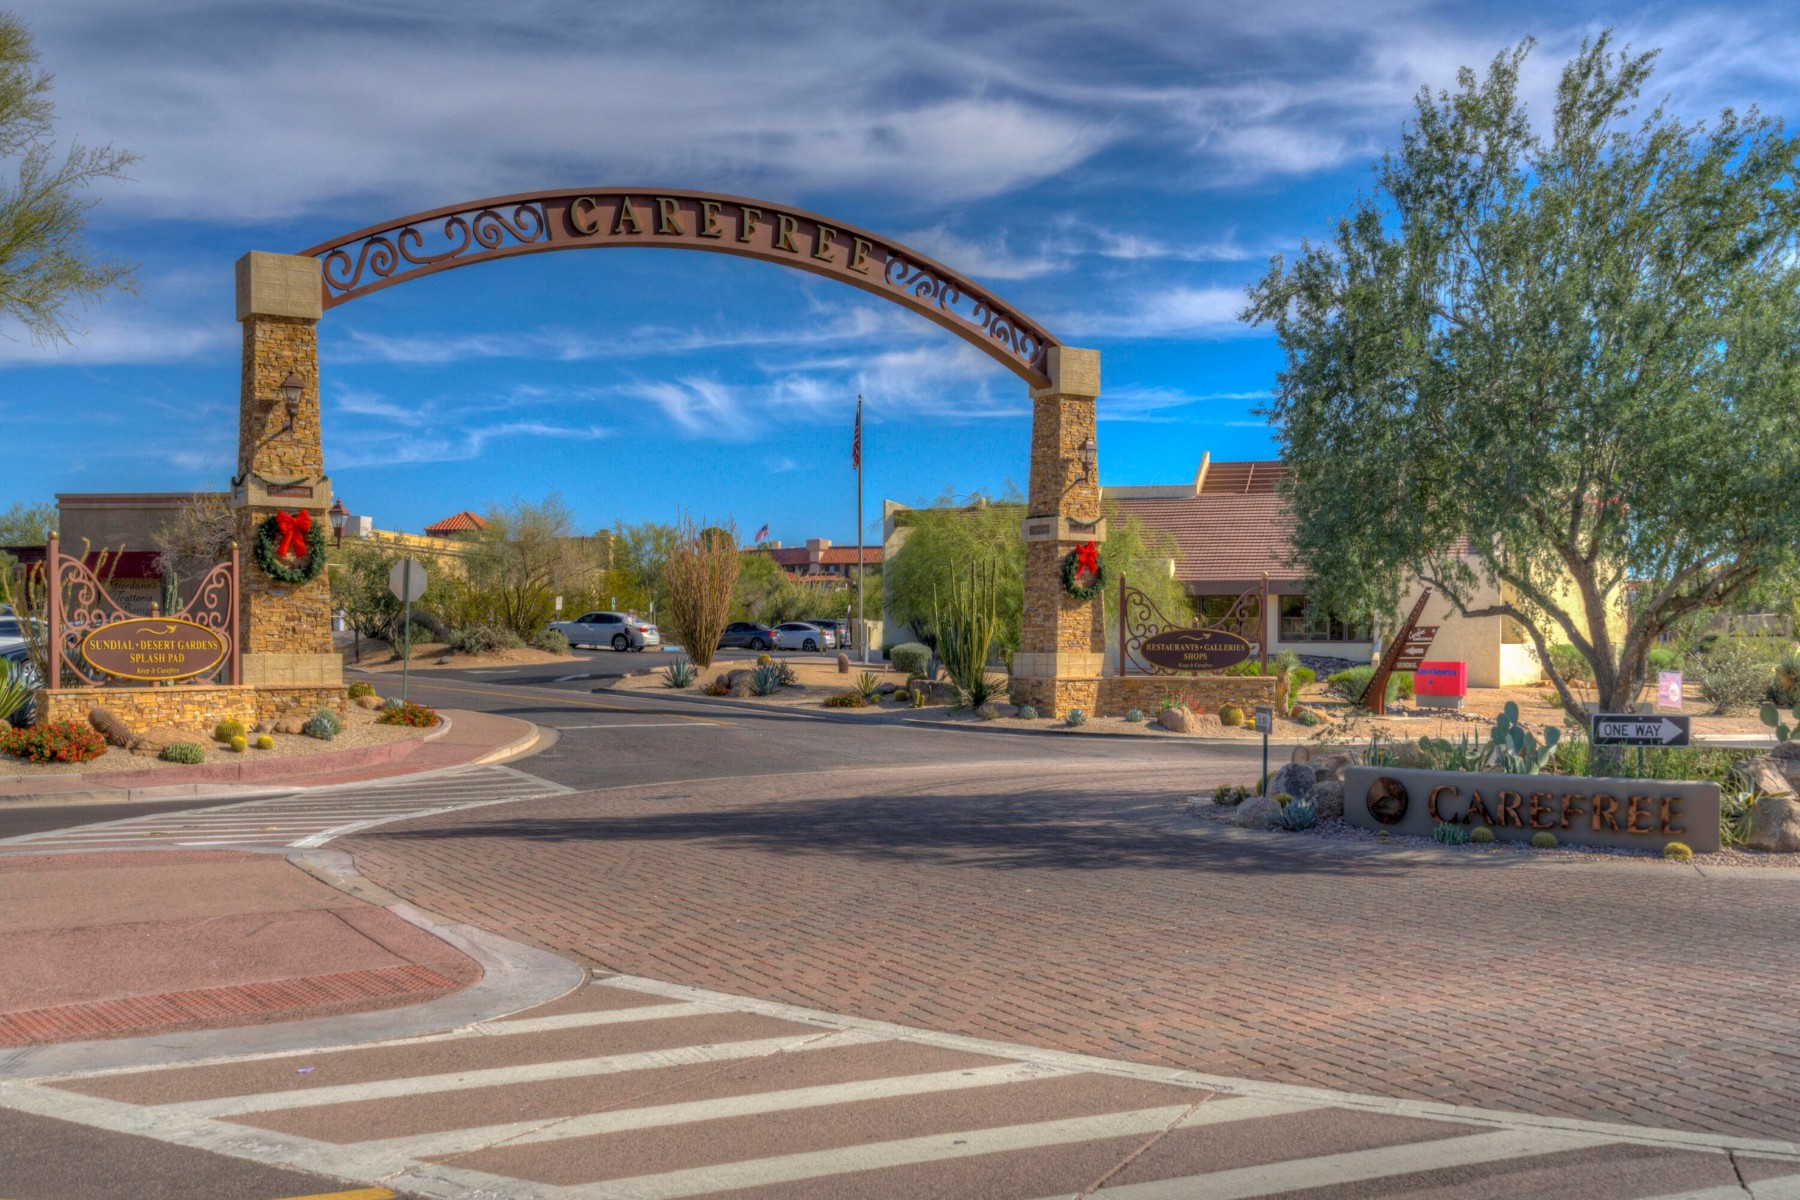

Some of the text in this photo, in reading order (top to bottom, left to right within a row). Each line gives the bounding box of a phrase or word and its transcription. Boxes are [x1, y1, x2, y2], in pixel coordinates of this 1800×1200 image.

[570, 196, 873, 275] CAREFREE
[114, 590, 153, 602] Trattoria
[89, 640, 218, 650] SUNDIAL DESERT GARDENS
[1146, 643, 1246, 651] RESTAURANTS GALLERIES
[130, 653, 185, 663] SPLASH PAD
[136, 667, 149, 675] Keep
[156, 667, 180, 675] Carefree
[1604, 724, 1661, 737] ONE WAY
[1427, 784, 1686, 835] CAREFREE
